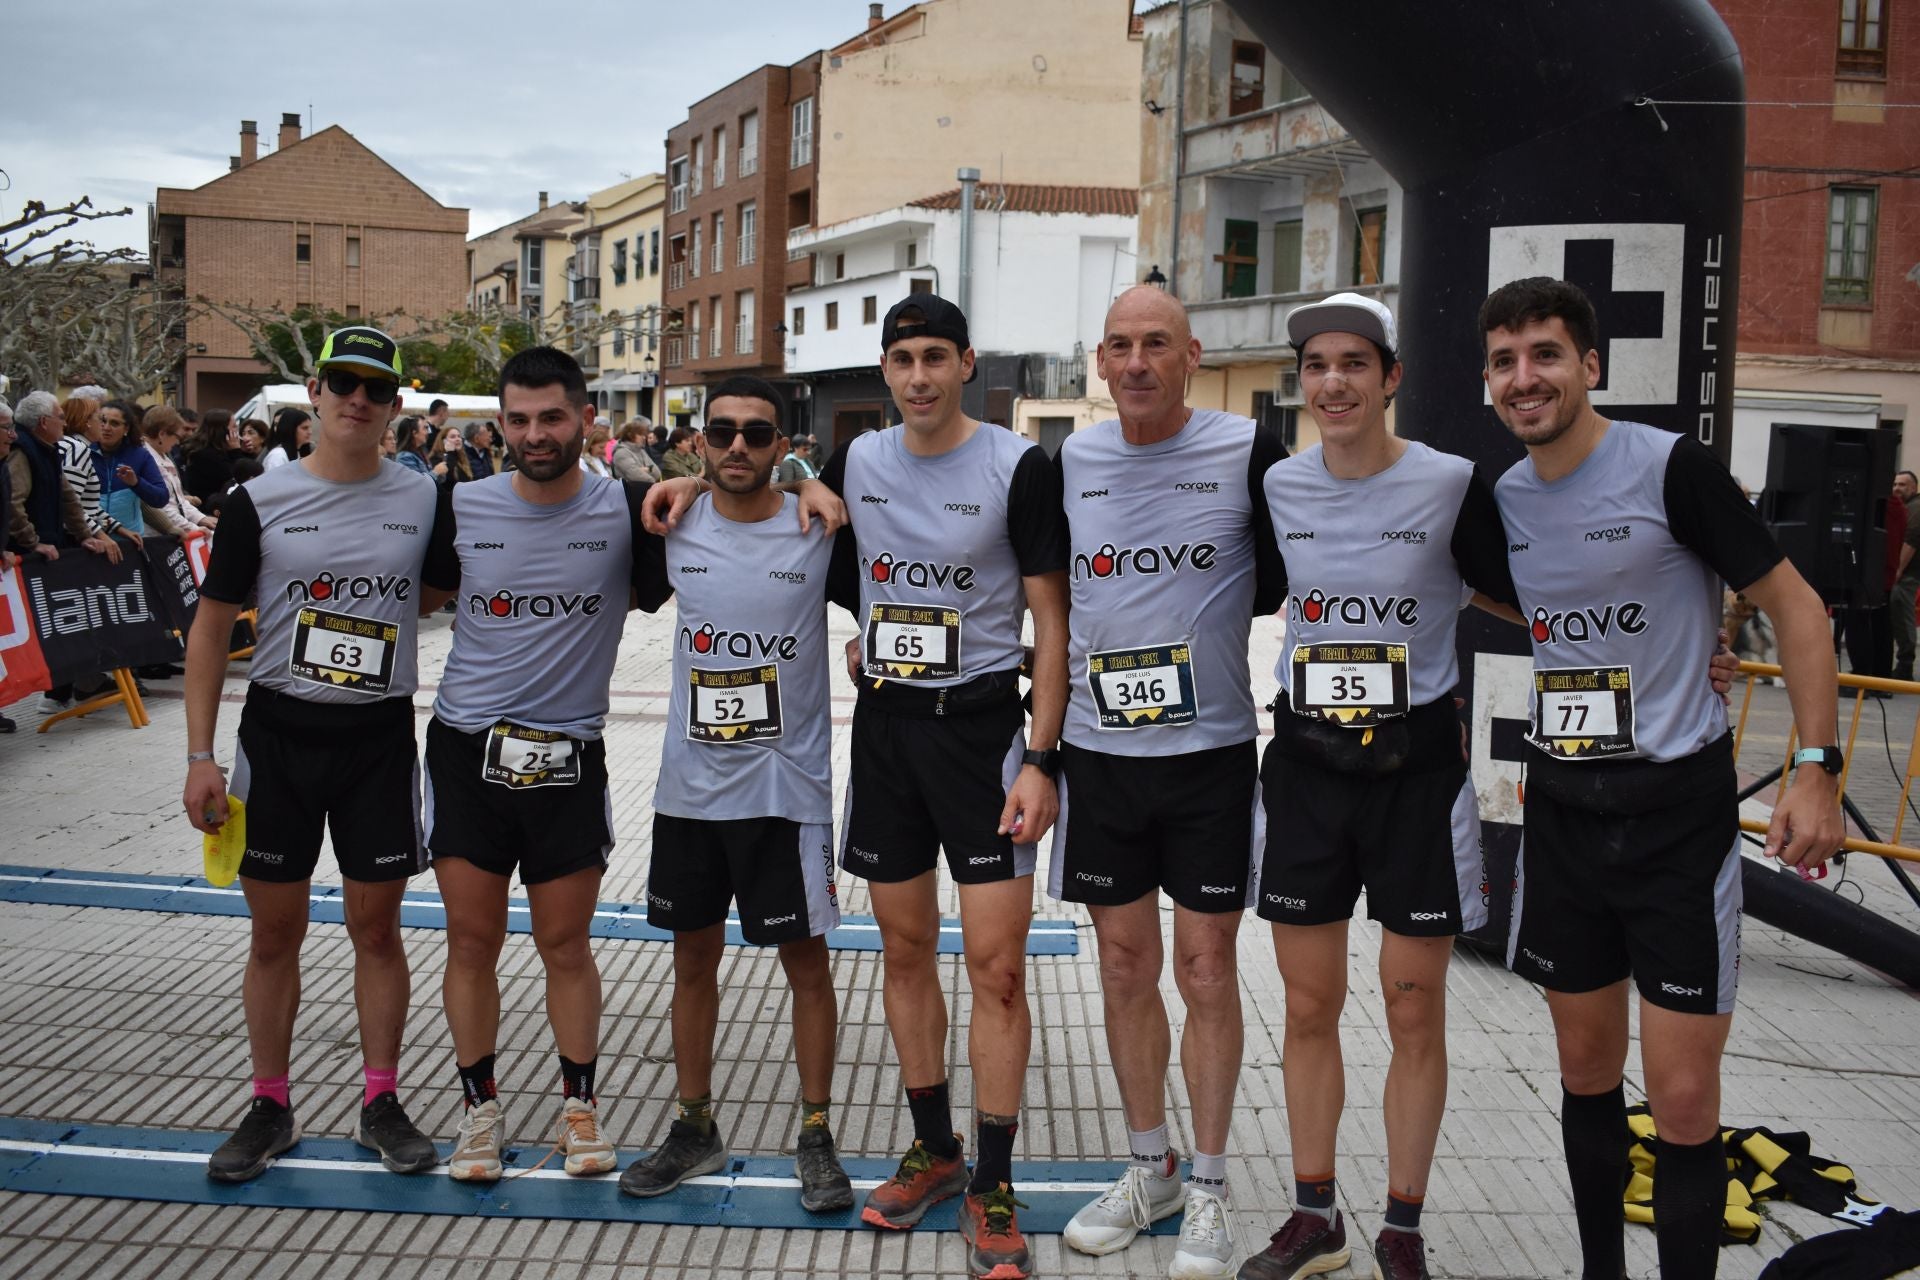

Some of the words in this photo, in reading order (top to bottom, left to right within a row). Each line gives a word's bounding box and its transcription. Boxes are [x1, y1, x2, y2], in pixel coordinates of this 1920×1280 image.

[1175, 481, 1219, 491] norave
[944, 503, 981, 512] norave
[383, 523, 419, 532] norave
[1381, 530, 1427, 540] norave
[1585, 525, 1631, 542] norave
[567, 540, 608, 550] norave
[1607, 533, 1631, 543] SPORT
[1074, 542, 1217, 583] norave
[769, 571, 807, 580] norave
[862, 551, 976, 592] norave
[286, 570, 412, 603] norave
[469, 589, 602, 619] norave
[1292, 587, 1419, 628] norave
[325, 616, 353, 632] TRAIL
[1530, 601, 1649, 645] orave
[680, 621, 799, 661] norave
[894, 634, 924, 658] 65
[330, 644, 363, 667] 63
[1319, 647, 1349, 660] TRAIL
[1108, 655, 1137, 669] TRAIL
[703, 673, 729, 686] TRAIL
[1548, 675, 1574, 689] TRAIL
[1116, 679, 1166, 706] 346
[1331, 675, 1367, 701] 35
[714, 697, 746, 720] 52
[1558, 705, 1589, 731] 77
[522, 752, 552, 771] 25
[246, 849, 284, 861] norave
[1076, 871, 1113, 884] norave
[1265, 893, 1306, 907] norave
